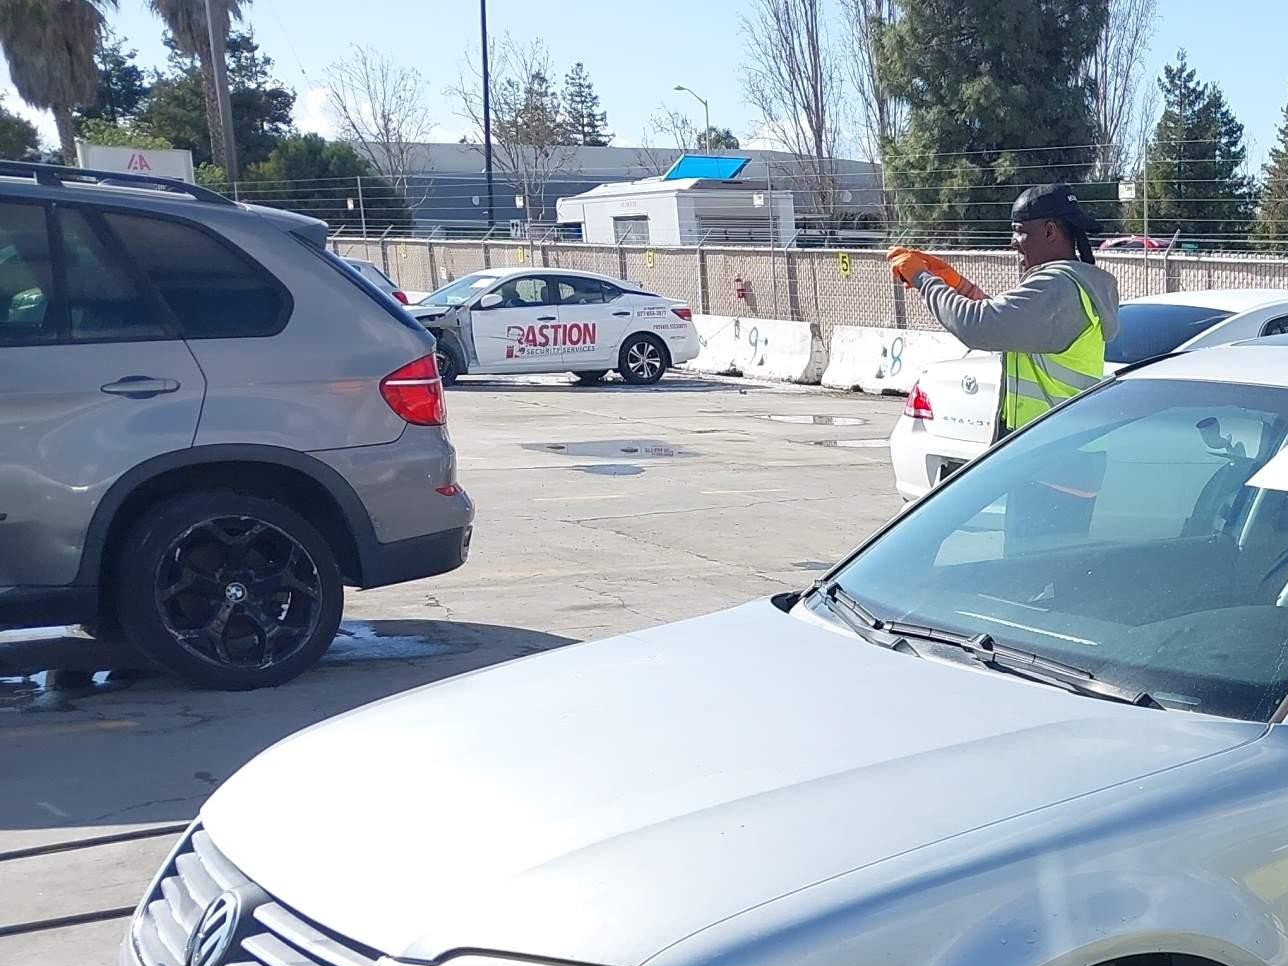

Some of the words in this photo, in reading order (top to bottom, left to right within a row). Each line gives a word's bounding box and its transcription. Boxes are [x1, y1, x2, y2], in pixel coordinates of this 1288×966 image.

[841, 255, 849, 272] 5
[526, 346, 560, 355] SECURITY
[562, 345, 595, 353] SERVICES
[890, 336, 904, 377] 8
